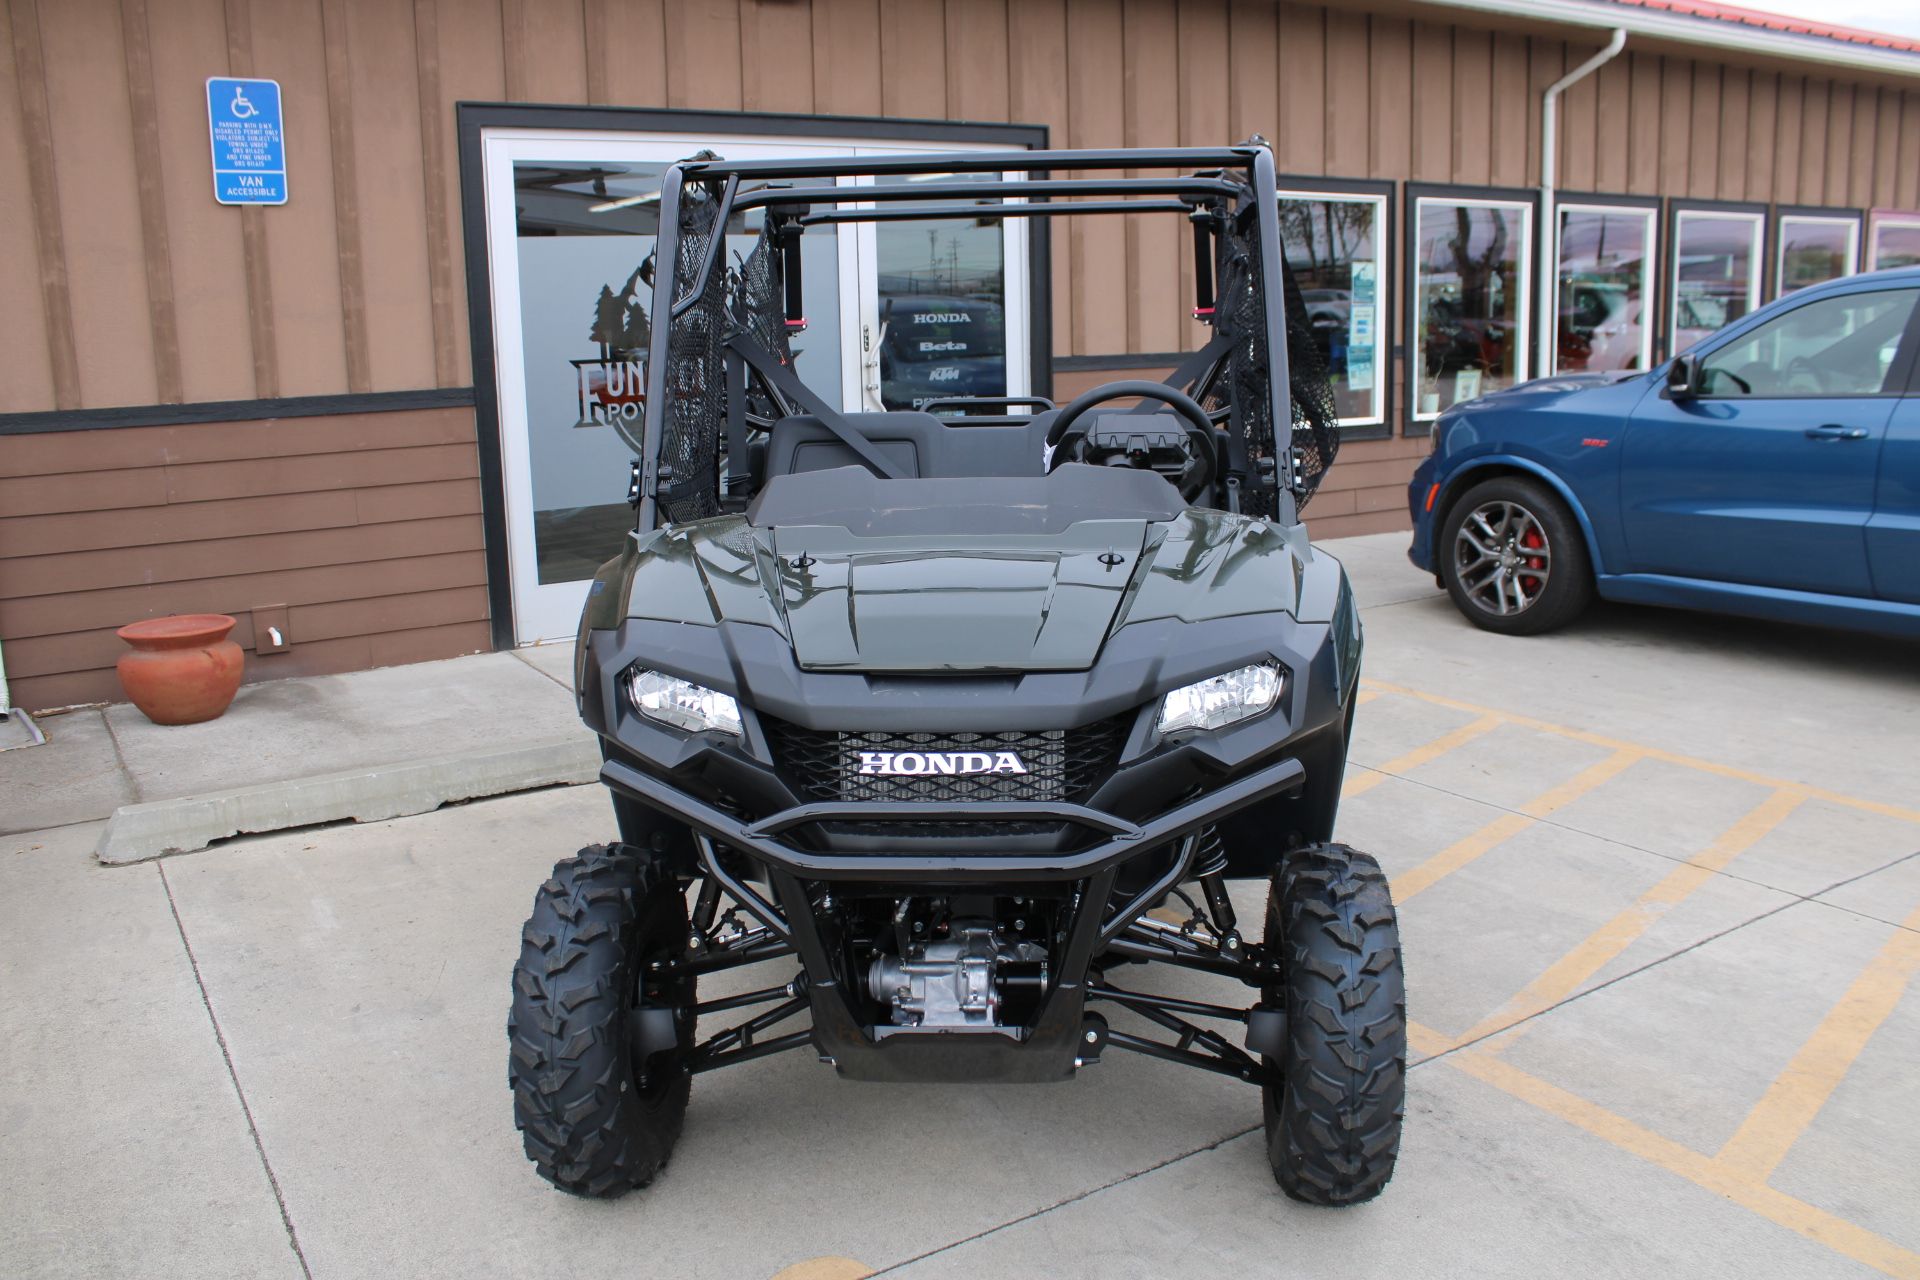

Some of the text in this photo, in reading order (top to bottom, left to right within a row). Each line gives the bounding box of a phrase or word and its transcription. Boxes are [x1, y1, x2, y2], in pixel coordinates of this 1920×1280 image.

[216, 134, 245, 142] VIOLATORS
[238, 175, 263, 186] VAN
[227, 187, 276, 197] ACCESSIBLE
[913, 313, 971, 324] HONDA
[919, 341, 967, 351] Beta
[929, 367, 960, 382] KTM
[859, 751, 1027, 775] HONDA
